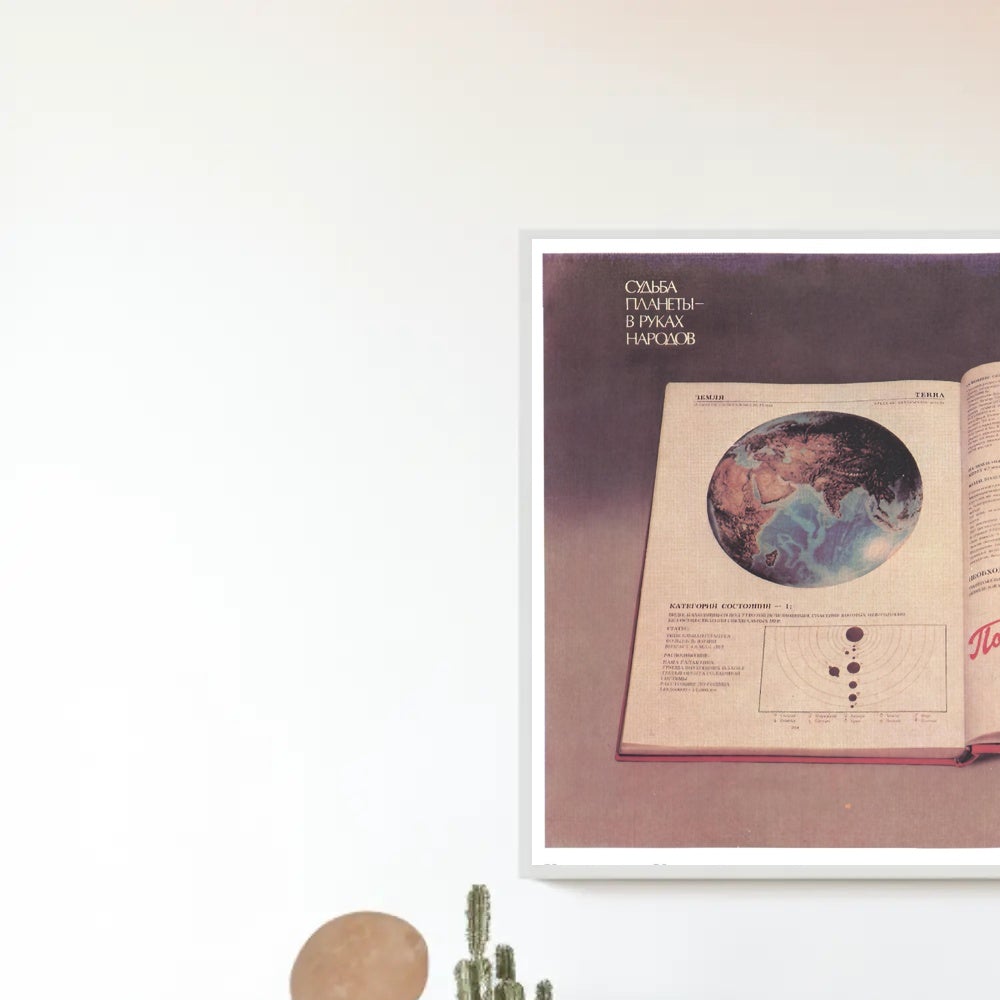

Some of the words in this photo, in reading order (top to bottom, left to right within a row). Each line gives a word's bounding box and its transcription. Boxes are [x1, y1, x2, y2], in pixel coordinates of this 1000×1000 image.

[625, 279, 678, 294] СУДЬБА
[625, 315, 635, 328] В
[639, 315, 684, 329] РУКАХ
[626, 332, 696, 346] НАРОДОВ
